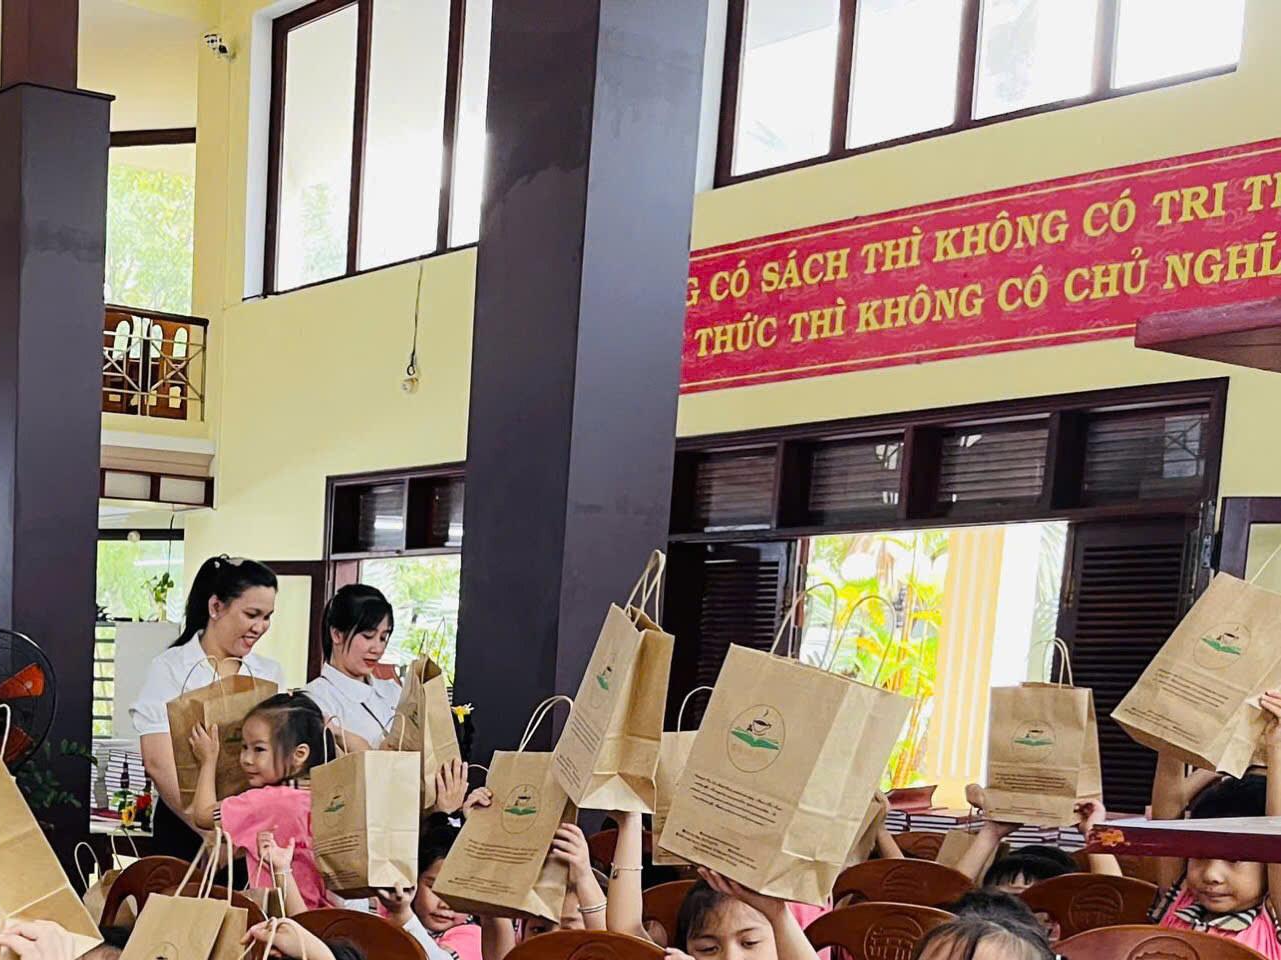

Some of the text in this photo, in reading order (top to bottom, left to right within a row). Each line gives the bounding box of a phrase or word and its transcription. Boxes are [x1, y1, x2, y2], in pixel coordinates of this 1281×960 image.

[693, 231, 1281, 358] THỨC THÌ KHÔNG CÓ CHỦ NGHĨ
[709, 259, 750, 301] CÓ
[760, 249, 851, 292] SÁCH
[860, 226, 923, 275] THÌ
[932, 209, 1070, 263] KHÔNG
[1082, 188, 1136, 238] CÓ
[1152, 181, 1229, 227] TRI
